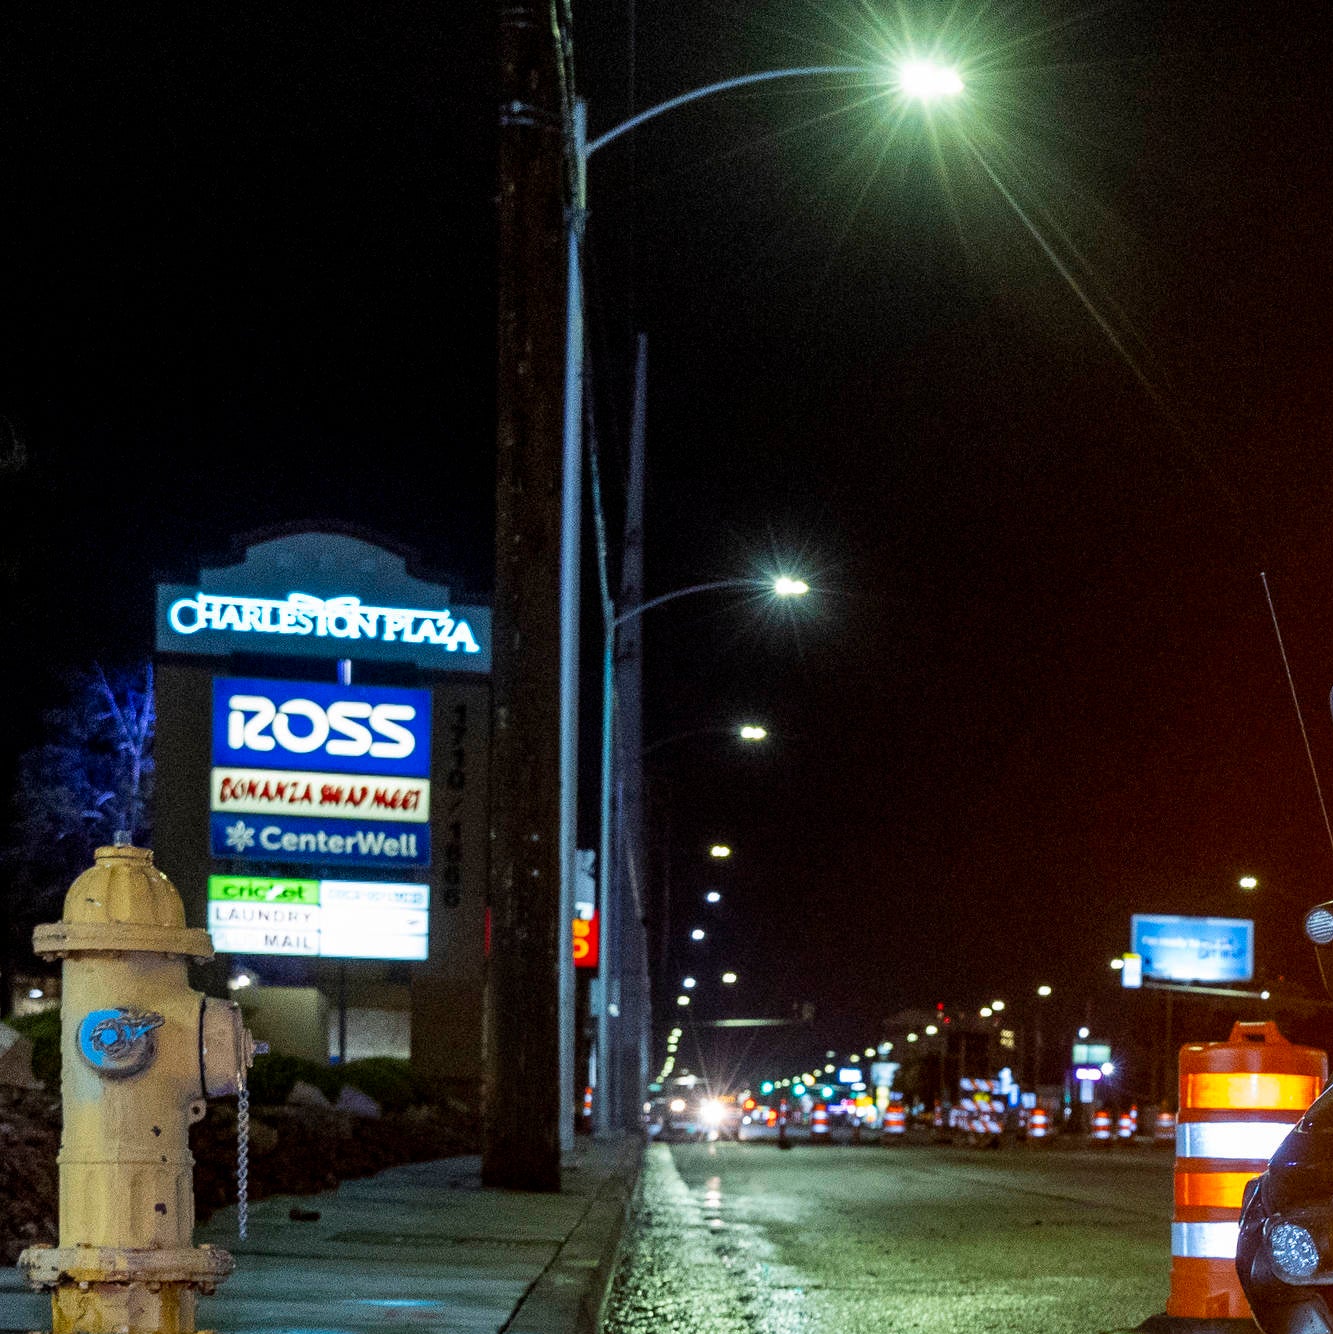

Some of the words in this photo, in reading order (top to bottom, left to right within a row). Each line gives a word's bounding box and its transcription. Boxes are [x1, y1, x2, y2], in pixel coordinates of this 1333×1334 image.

[169, 597, 378, 640] CHARLESTON
[383, 609, 480, 653] PLAZA
[228, 694, 416, 759] ROSS
[220, 777, 314, 805] BONANZA
[259, 826, 418, 858] CenterWell
[215, 907, 312, 924] LAUNDRY
[264, 933, 312, 950] MAIL
